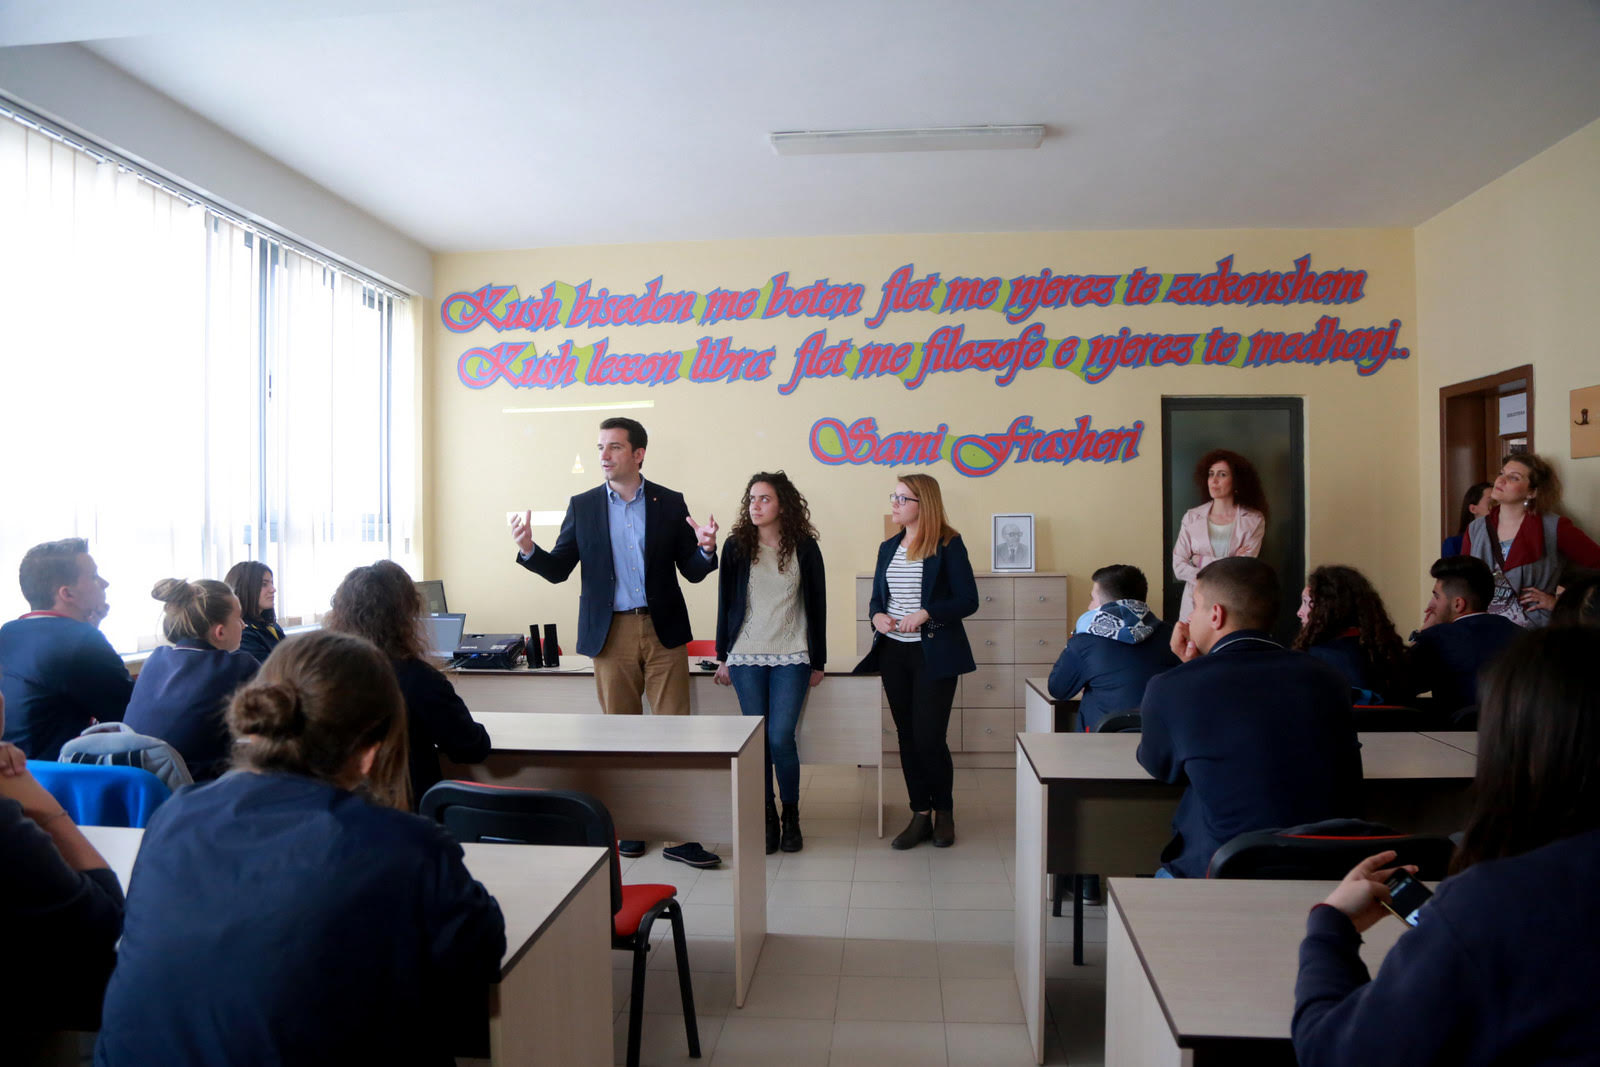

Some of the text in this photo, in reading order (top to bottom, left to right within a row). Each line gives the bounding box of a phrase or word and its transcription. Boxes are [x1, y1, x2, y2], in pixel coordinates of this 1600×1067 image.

[442, 255, 1366, 331] Kush bisedon me boten flet me njerez te zakonshem
[459, 341, 577, 388] Kush
[586, 338, 682, 385] lexon
[690, 337, 775, 382] libra
[778, 330, 852, 394] flet
[855, 342, 914, 378] me
[905, 324, 1048, 389] filozofe
[1052, 336, 1081, 369] e
[1082, 327, 1198, 383] njerez
[1202, 328, 1240, 364] te
[810, 418, 948, 465] Sami
